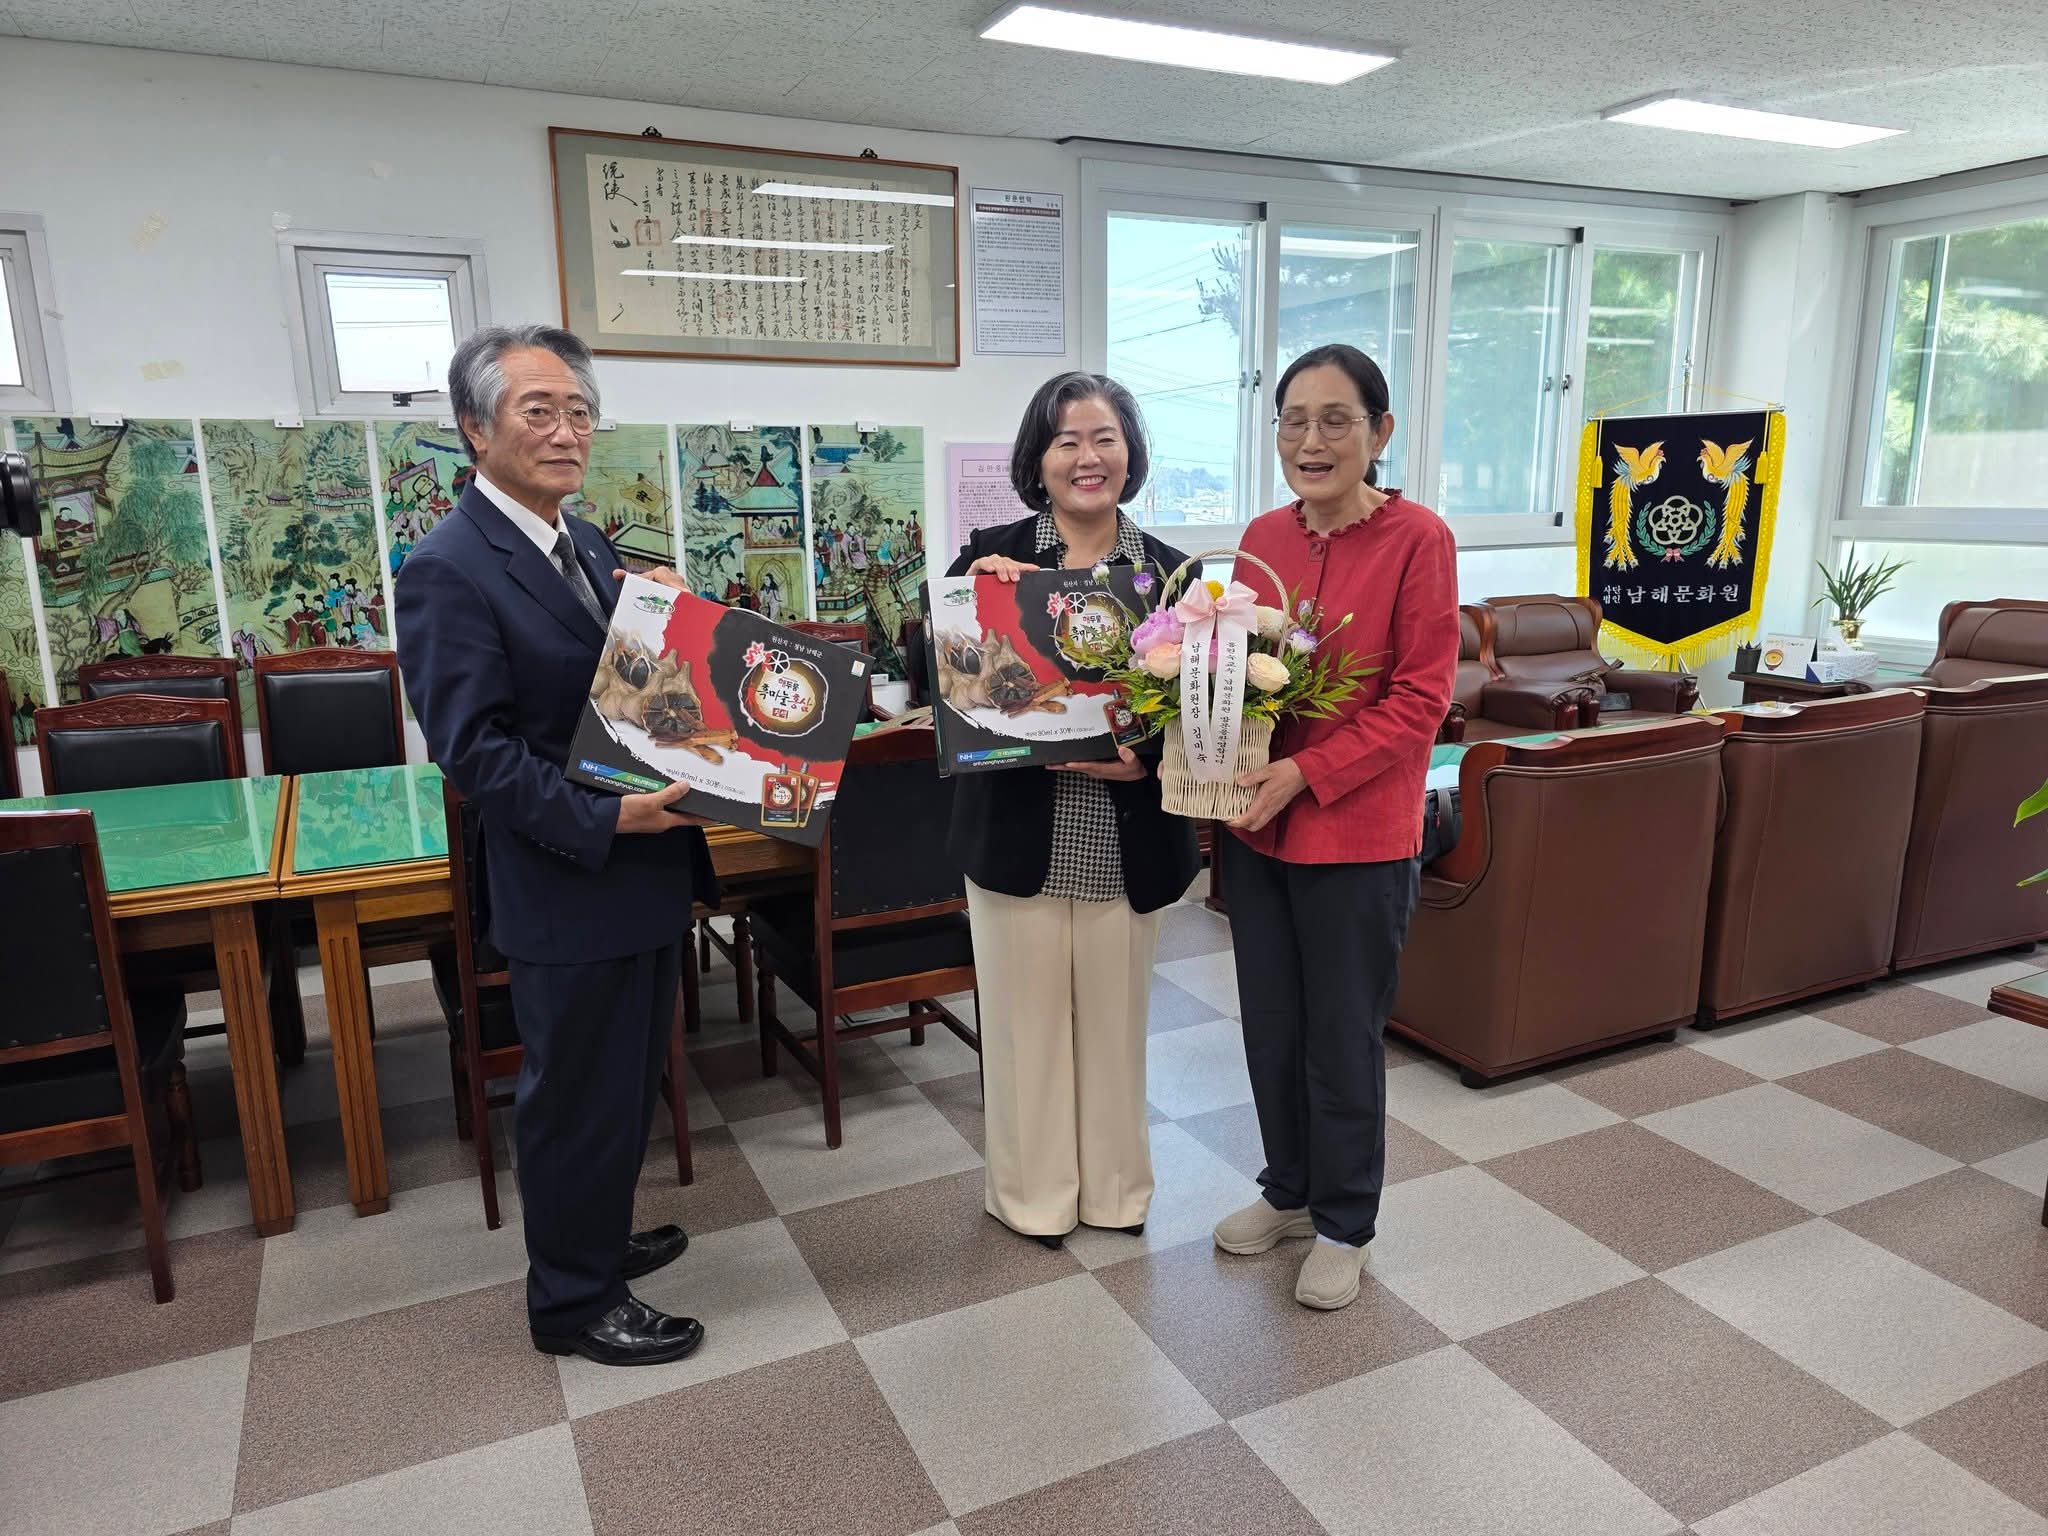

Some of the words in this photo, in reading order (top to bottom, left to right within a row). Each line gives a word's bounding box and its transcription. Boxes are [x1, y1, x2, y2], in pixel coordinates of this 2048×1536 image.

[1602, 585, 1621, 595] 사단
[1626, 584, 1739, 604] 남해문화원
[1189, 642, 1202, 719] 남해문화원장
[757, 683, 813, 712] 흑마늘홍삼
[960, 753, 973, 761] NH
[582, 762, 599, 772] NH
[680, 771, 698, 783] 80ml
